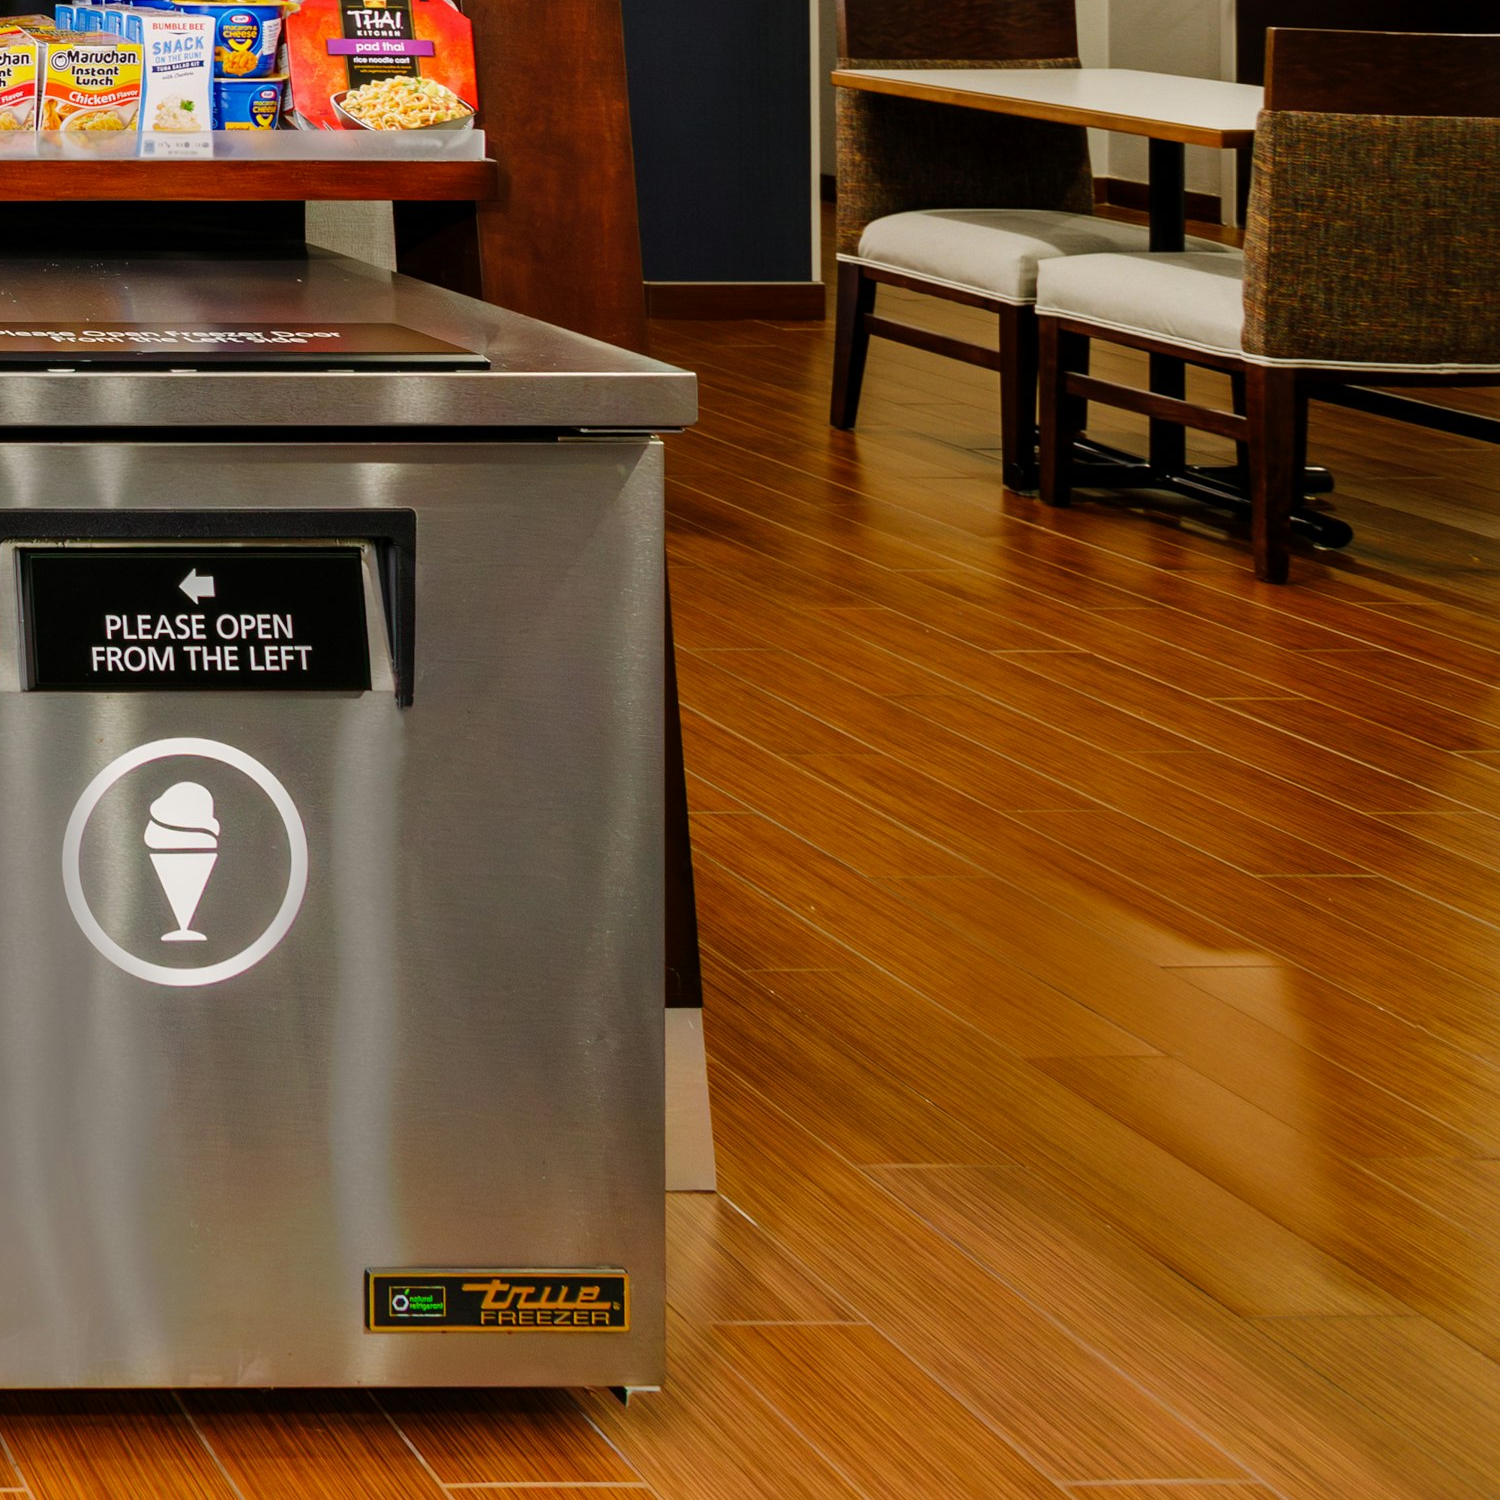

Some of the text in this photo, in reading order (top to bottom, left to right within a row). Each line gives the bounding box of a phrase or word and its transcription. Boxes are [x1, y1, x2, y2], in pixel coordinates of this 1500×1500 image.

[153, 23, 205, 31] BUMBLE BEE
[152, 36, 205, 55] SNACK
[356, 41, 405, 54] pad thai
[67, 51, 136, 65] Maruchan
[71, 66, 119, 76] Instant
[76, 75, 114, 86] Lunch
[82, 330, 161, 338] Open
[105, 614, 294, 640] PLEASE OPEN
[92, 645, 313, 672] FROM THE LEFT
[410, 1295, 433, 1303] natural
[462, 1279, 611, 1310] true
[409, 1302, 444, 1311] refrigerant
[480, 1311, 610, 1325] FREEZER
